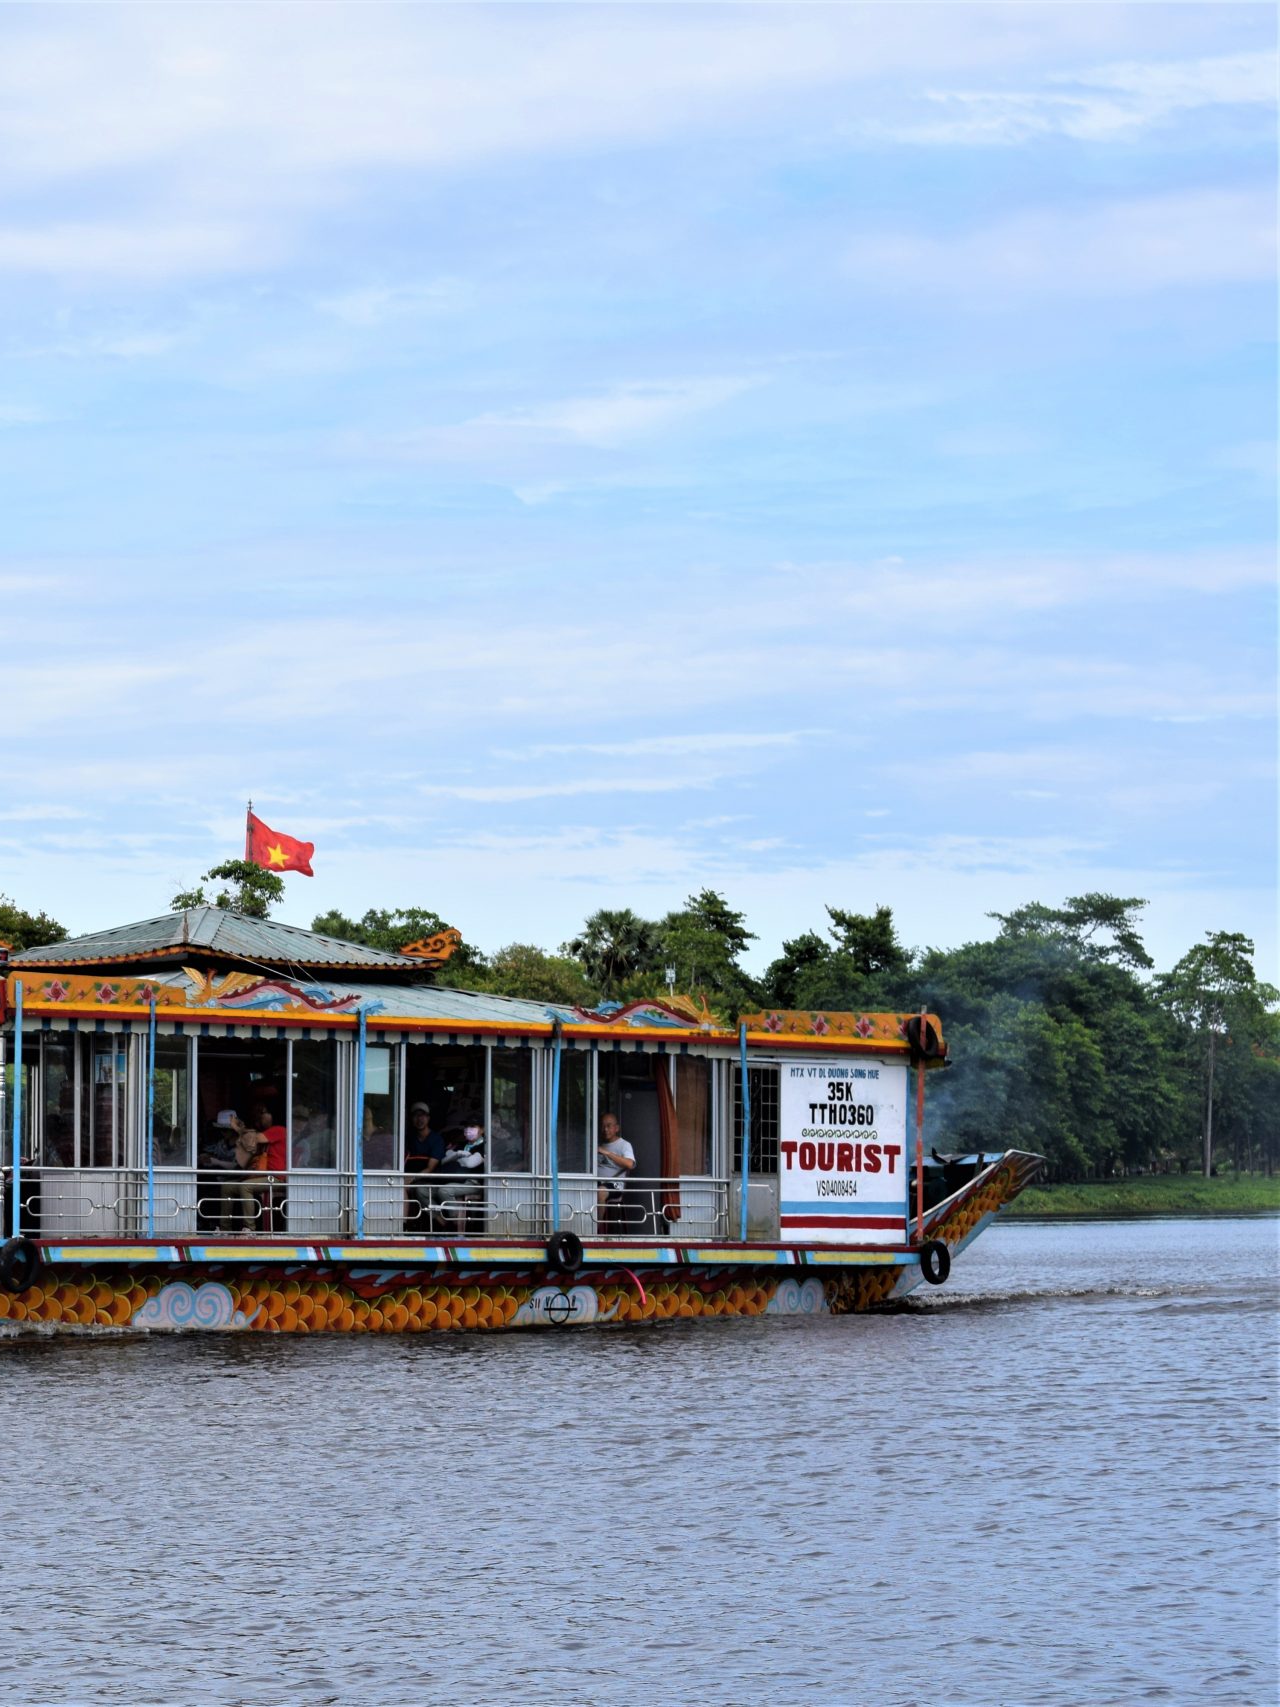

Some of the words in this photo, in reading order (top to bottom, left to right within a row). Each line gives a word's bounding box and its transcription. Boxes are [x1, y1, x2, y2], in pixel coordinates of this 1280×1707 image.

[807, 1067, 817, 1078] VT
[827, 1082, 853, 1102] 35K
[809, 1103, 874, 1125] TTH0360
[781, 1141, 901, 1174] TOURIST
